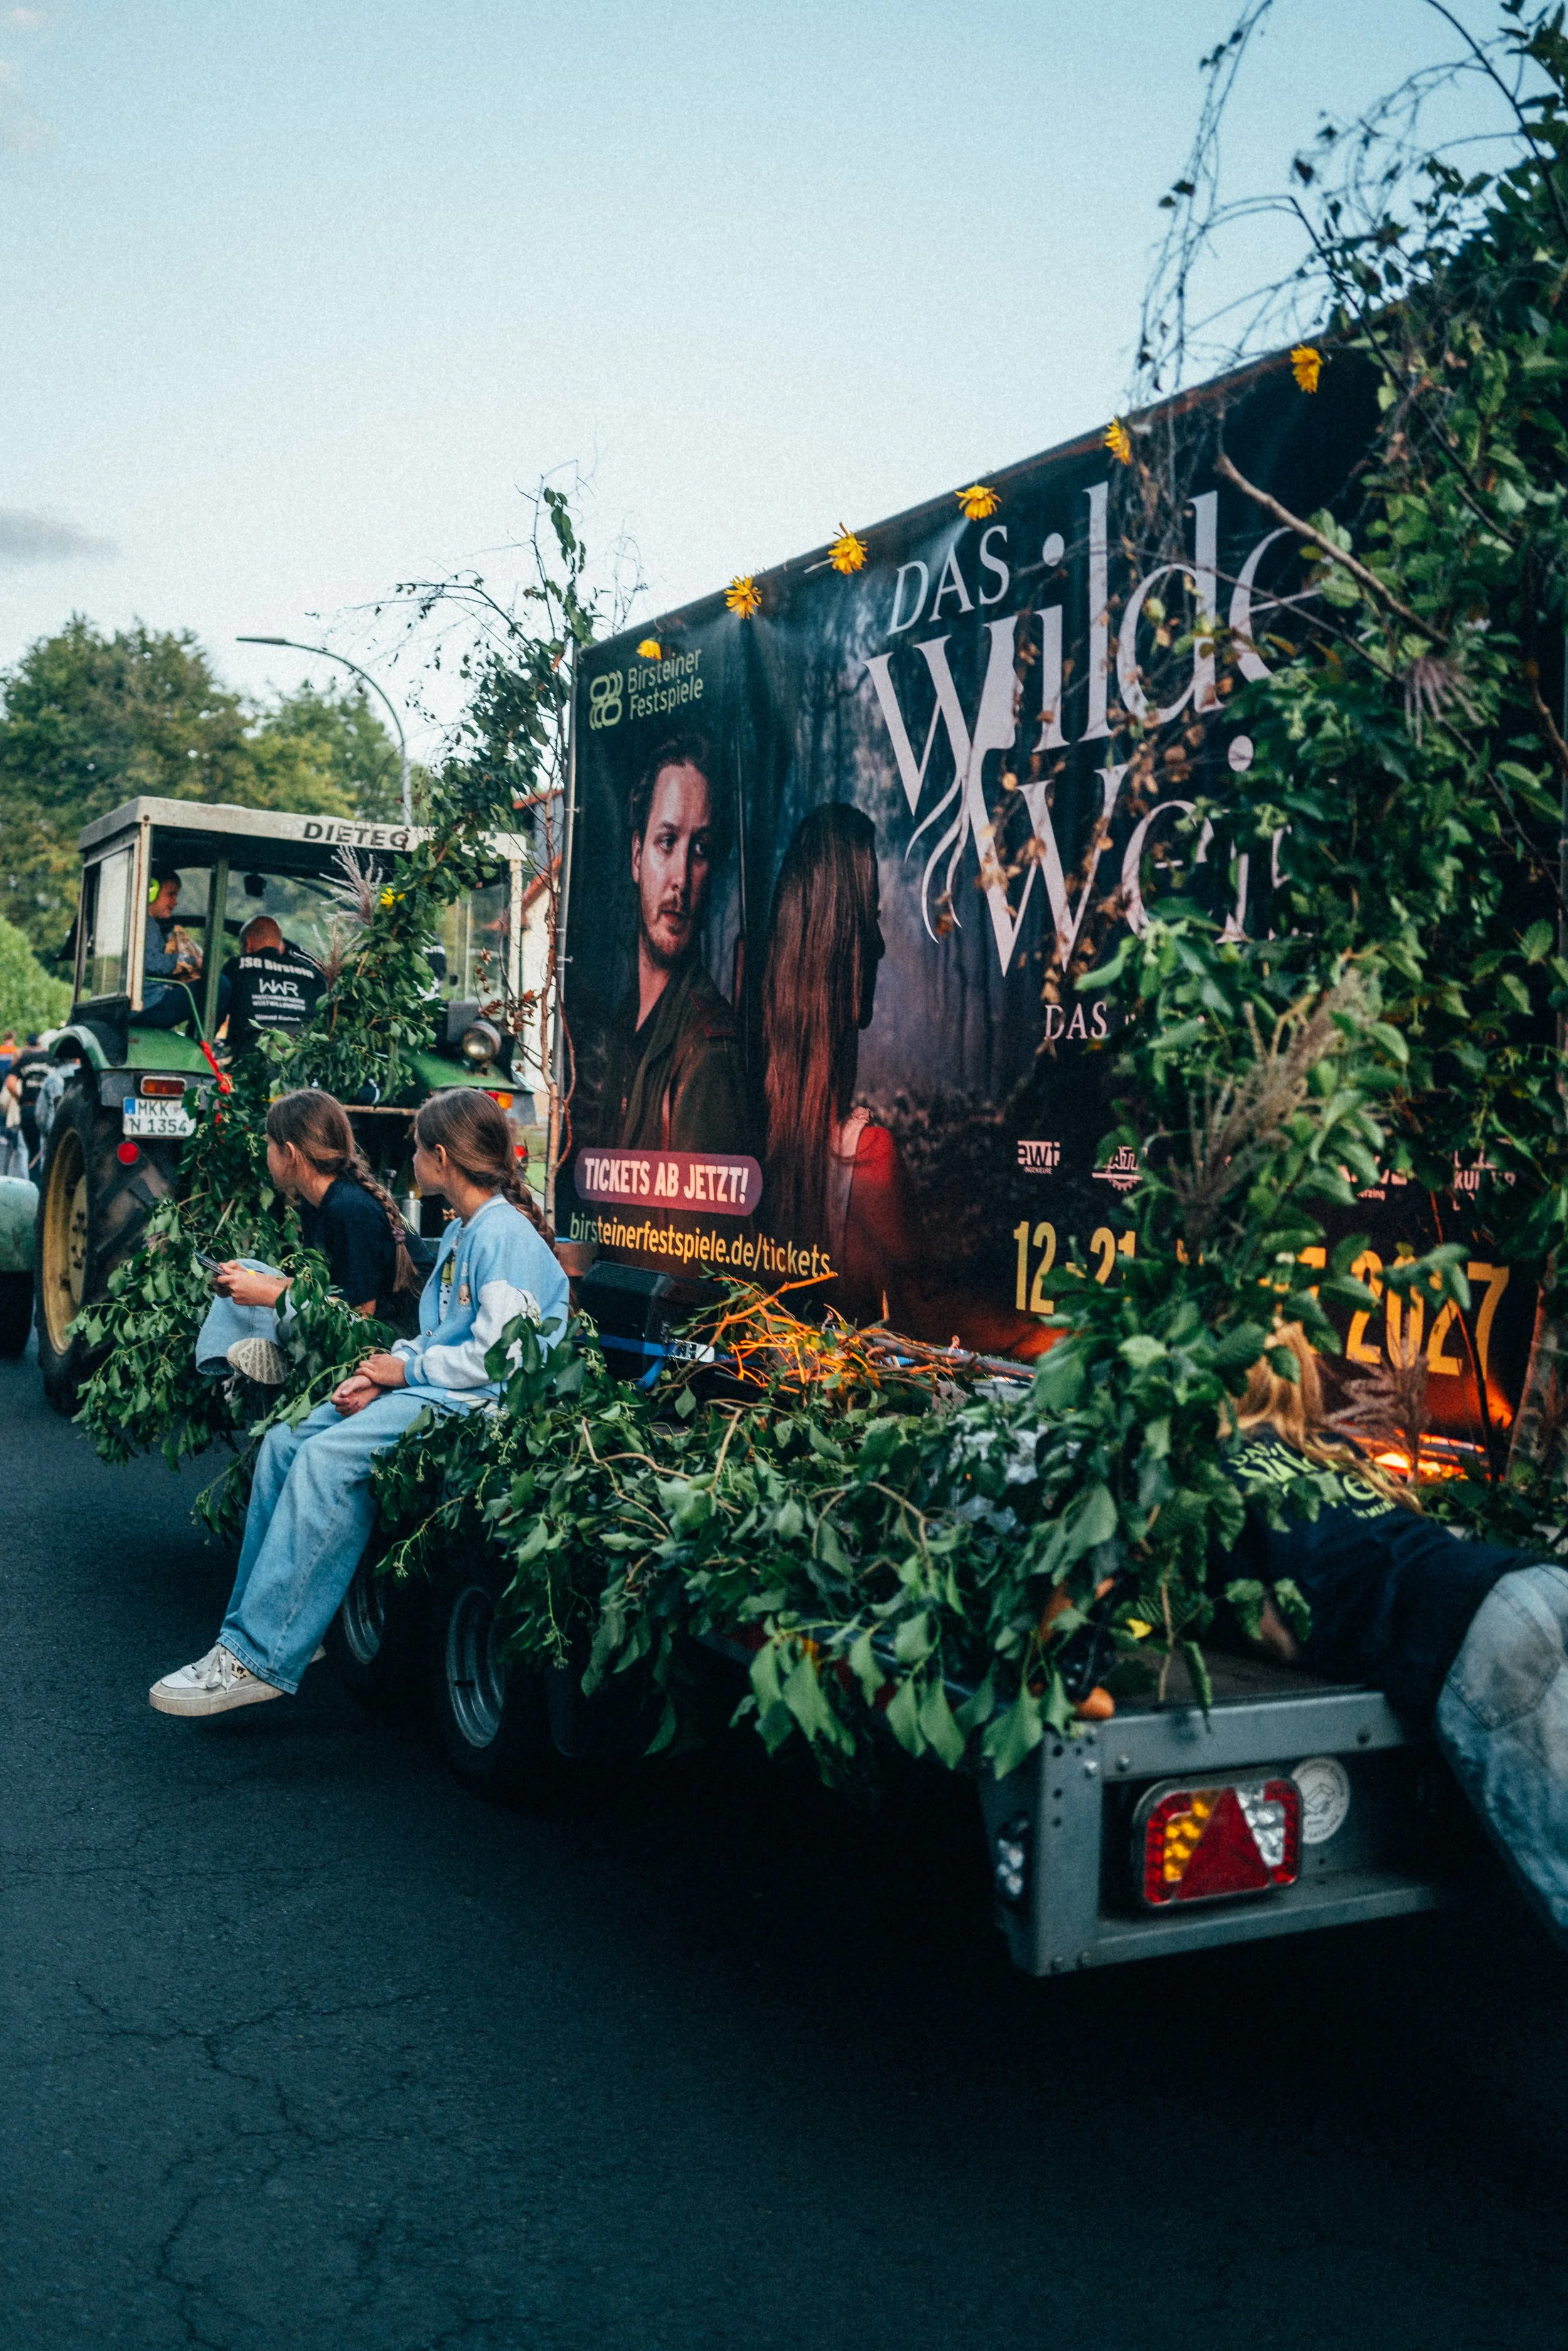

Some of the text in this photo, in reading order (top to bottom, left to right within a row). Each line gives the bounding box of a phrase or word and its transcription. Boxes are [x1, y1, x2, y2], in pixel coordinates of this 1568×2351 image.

[886, 525, 1009, 635] DAS
[628, 648, 702, 694] Birsteiner
[630, 676, 703, 720] Festspiele
[264, 958, 314, 979] Birstein
[1044, 1004, 1108, 1040] DAS
[129, 1118, 140, 1132] N
[139, 1100, 168, 1117] MKK
[585, 1158, 750, 1204] TICKETS AB JETZT!
[569, 1212, 831, 1278] birsteinerfestspiele.de/tickets
